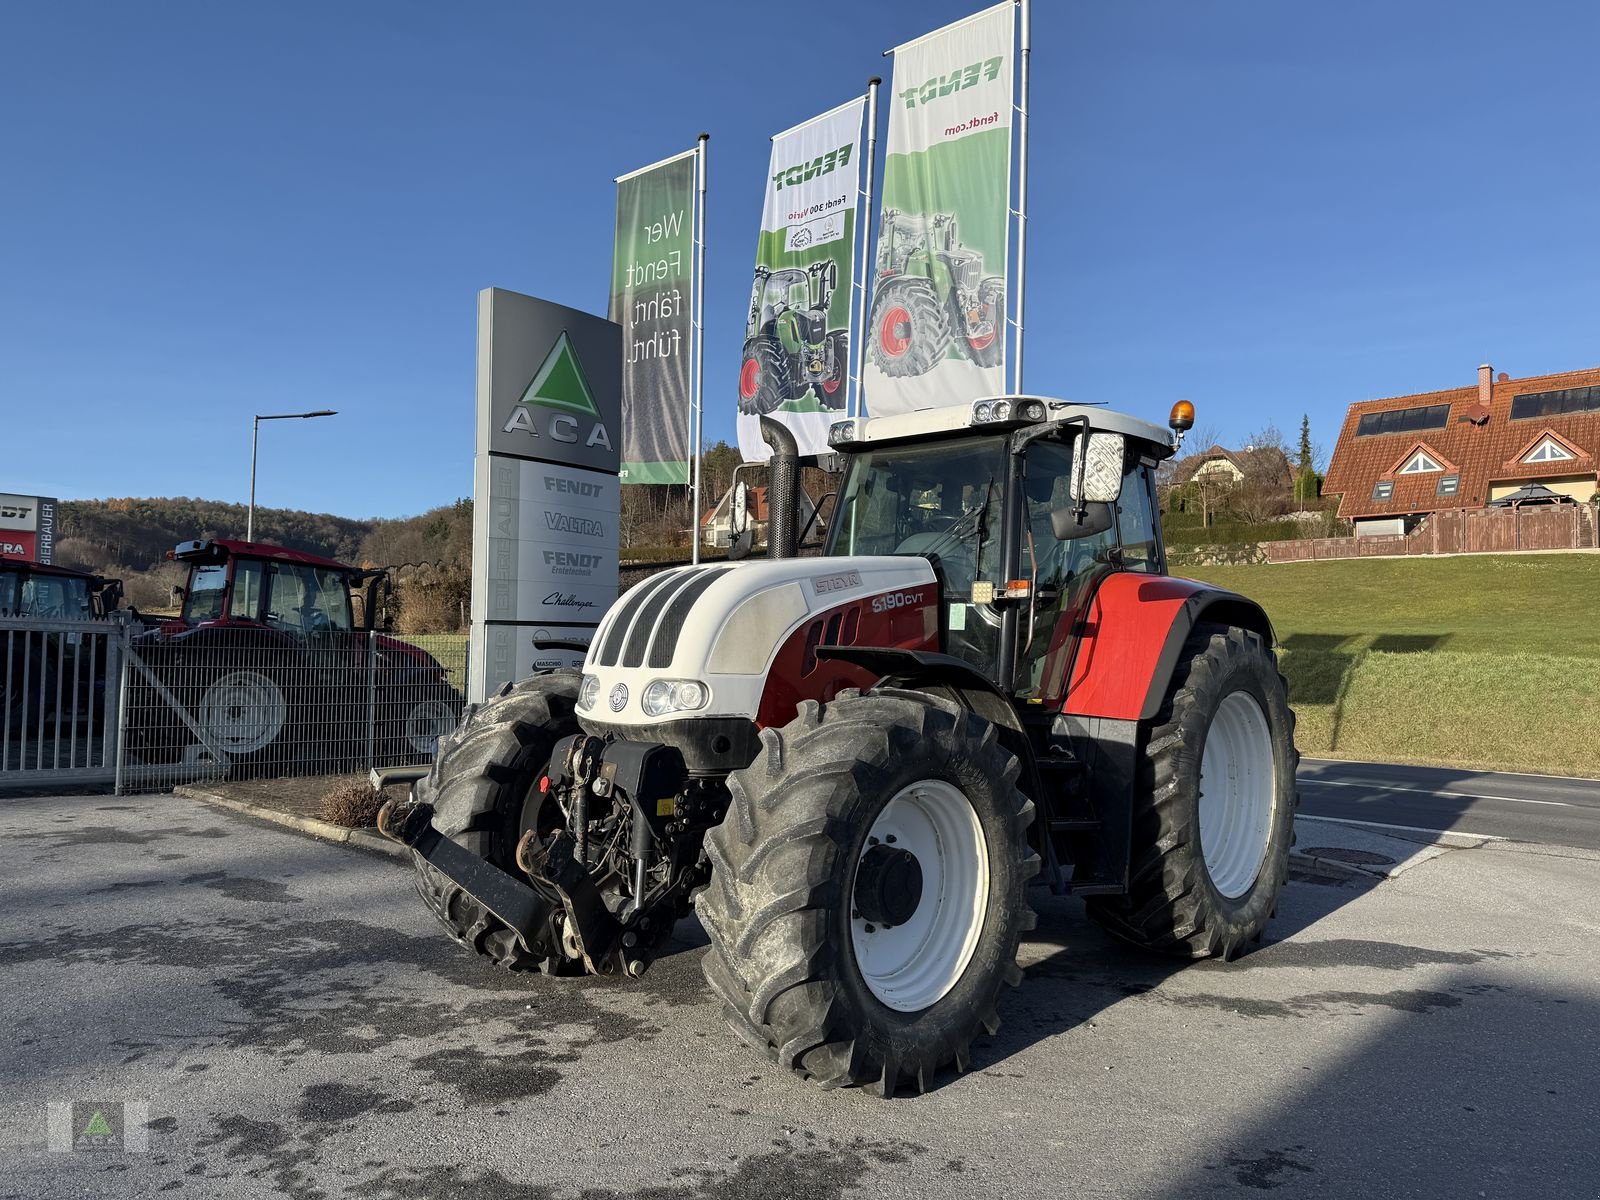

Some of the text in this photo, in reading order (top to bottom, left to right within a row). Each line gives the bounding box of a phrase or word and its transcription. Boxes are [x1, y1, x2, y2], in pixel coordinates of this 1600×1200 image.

[502, 405, 614, 452] ACA
[543, 476, 604, 498] FENDT
[40, 503, 54, 566] BIERBAUER
[544, 511, 604, 537] VALTRA
[542, 550, 603, 569] FENDT
[551, 566, 593, 577] Erntetechnik
[815, 572, 860, 593] STEYR
[541, 591, 601, 612] Challenger
